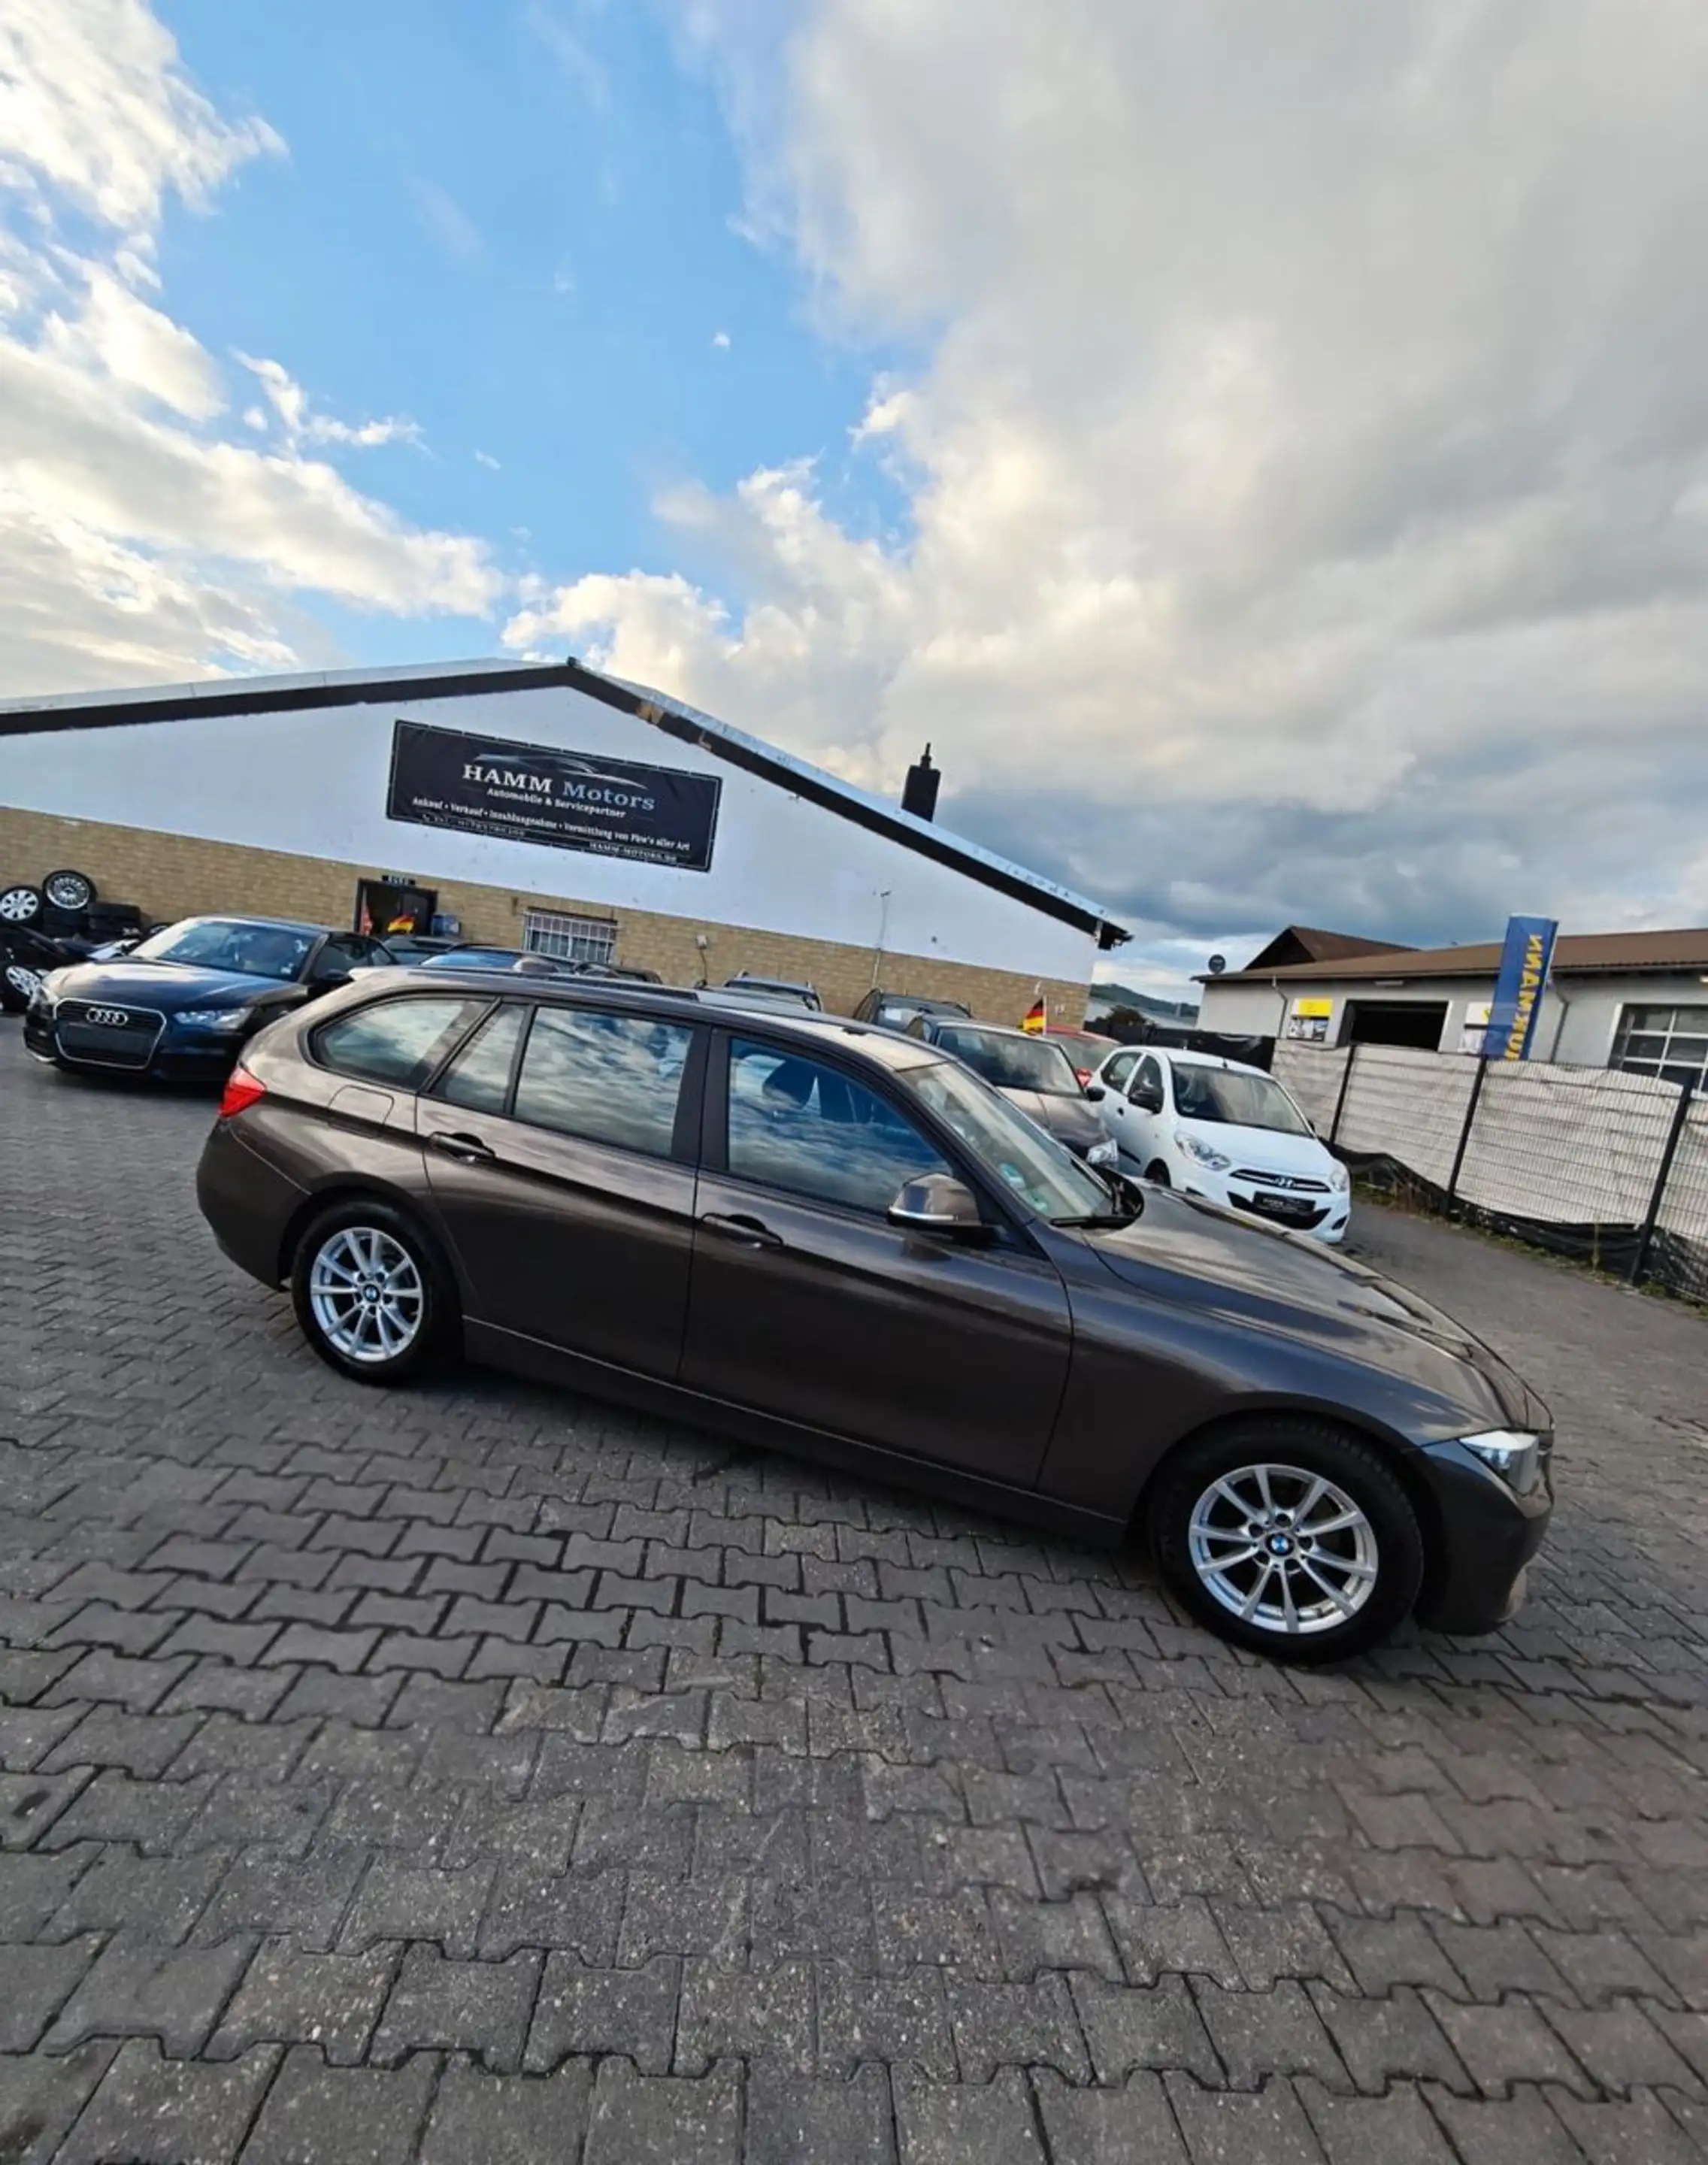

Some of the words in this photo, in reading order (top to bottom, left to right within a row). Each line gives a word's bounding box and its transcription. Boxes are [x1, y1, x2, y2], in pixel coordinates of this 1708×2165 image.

[462, 764, 553, 794] HAMM
[562, 781, 656, 810] Motors
[487, 787, 543, 805] Automobile
[545, 797, 553, 806] &
[555, 798, 626, 819] Servicepartner
[412, 796, 443, 809] Ankauf
[450, 803, 483, 816] Verkauf
[677, 841, 691, 851] Art
